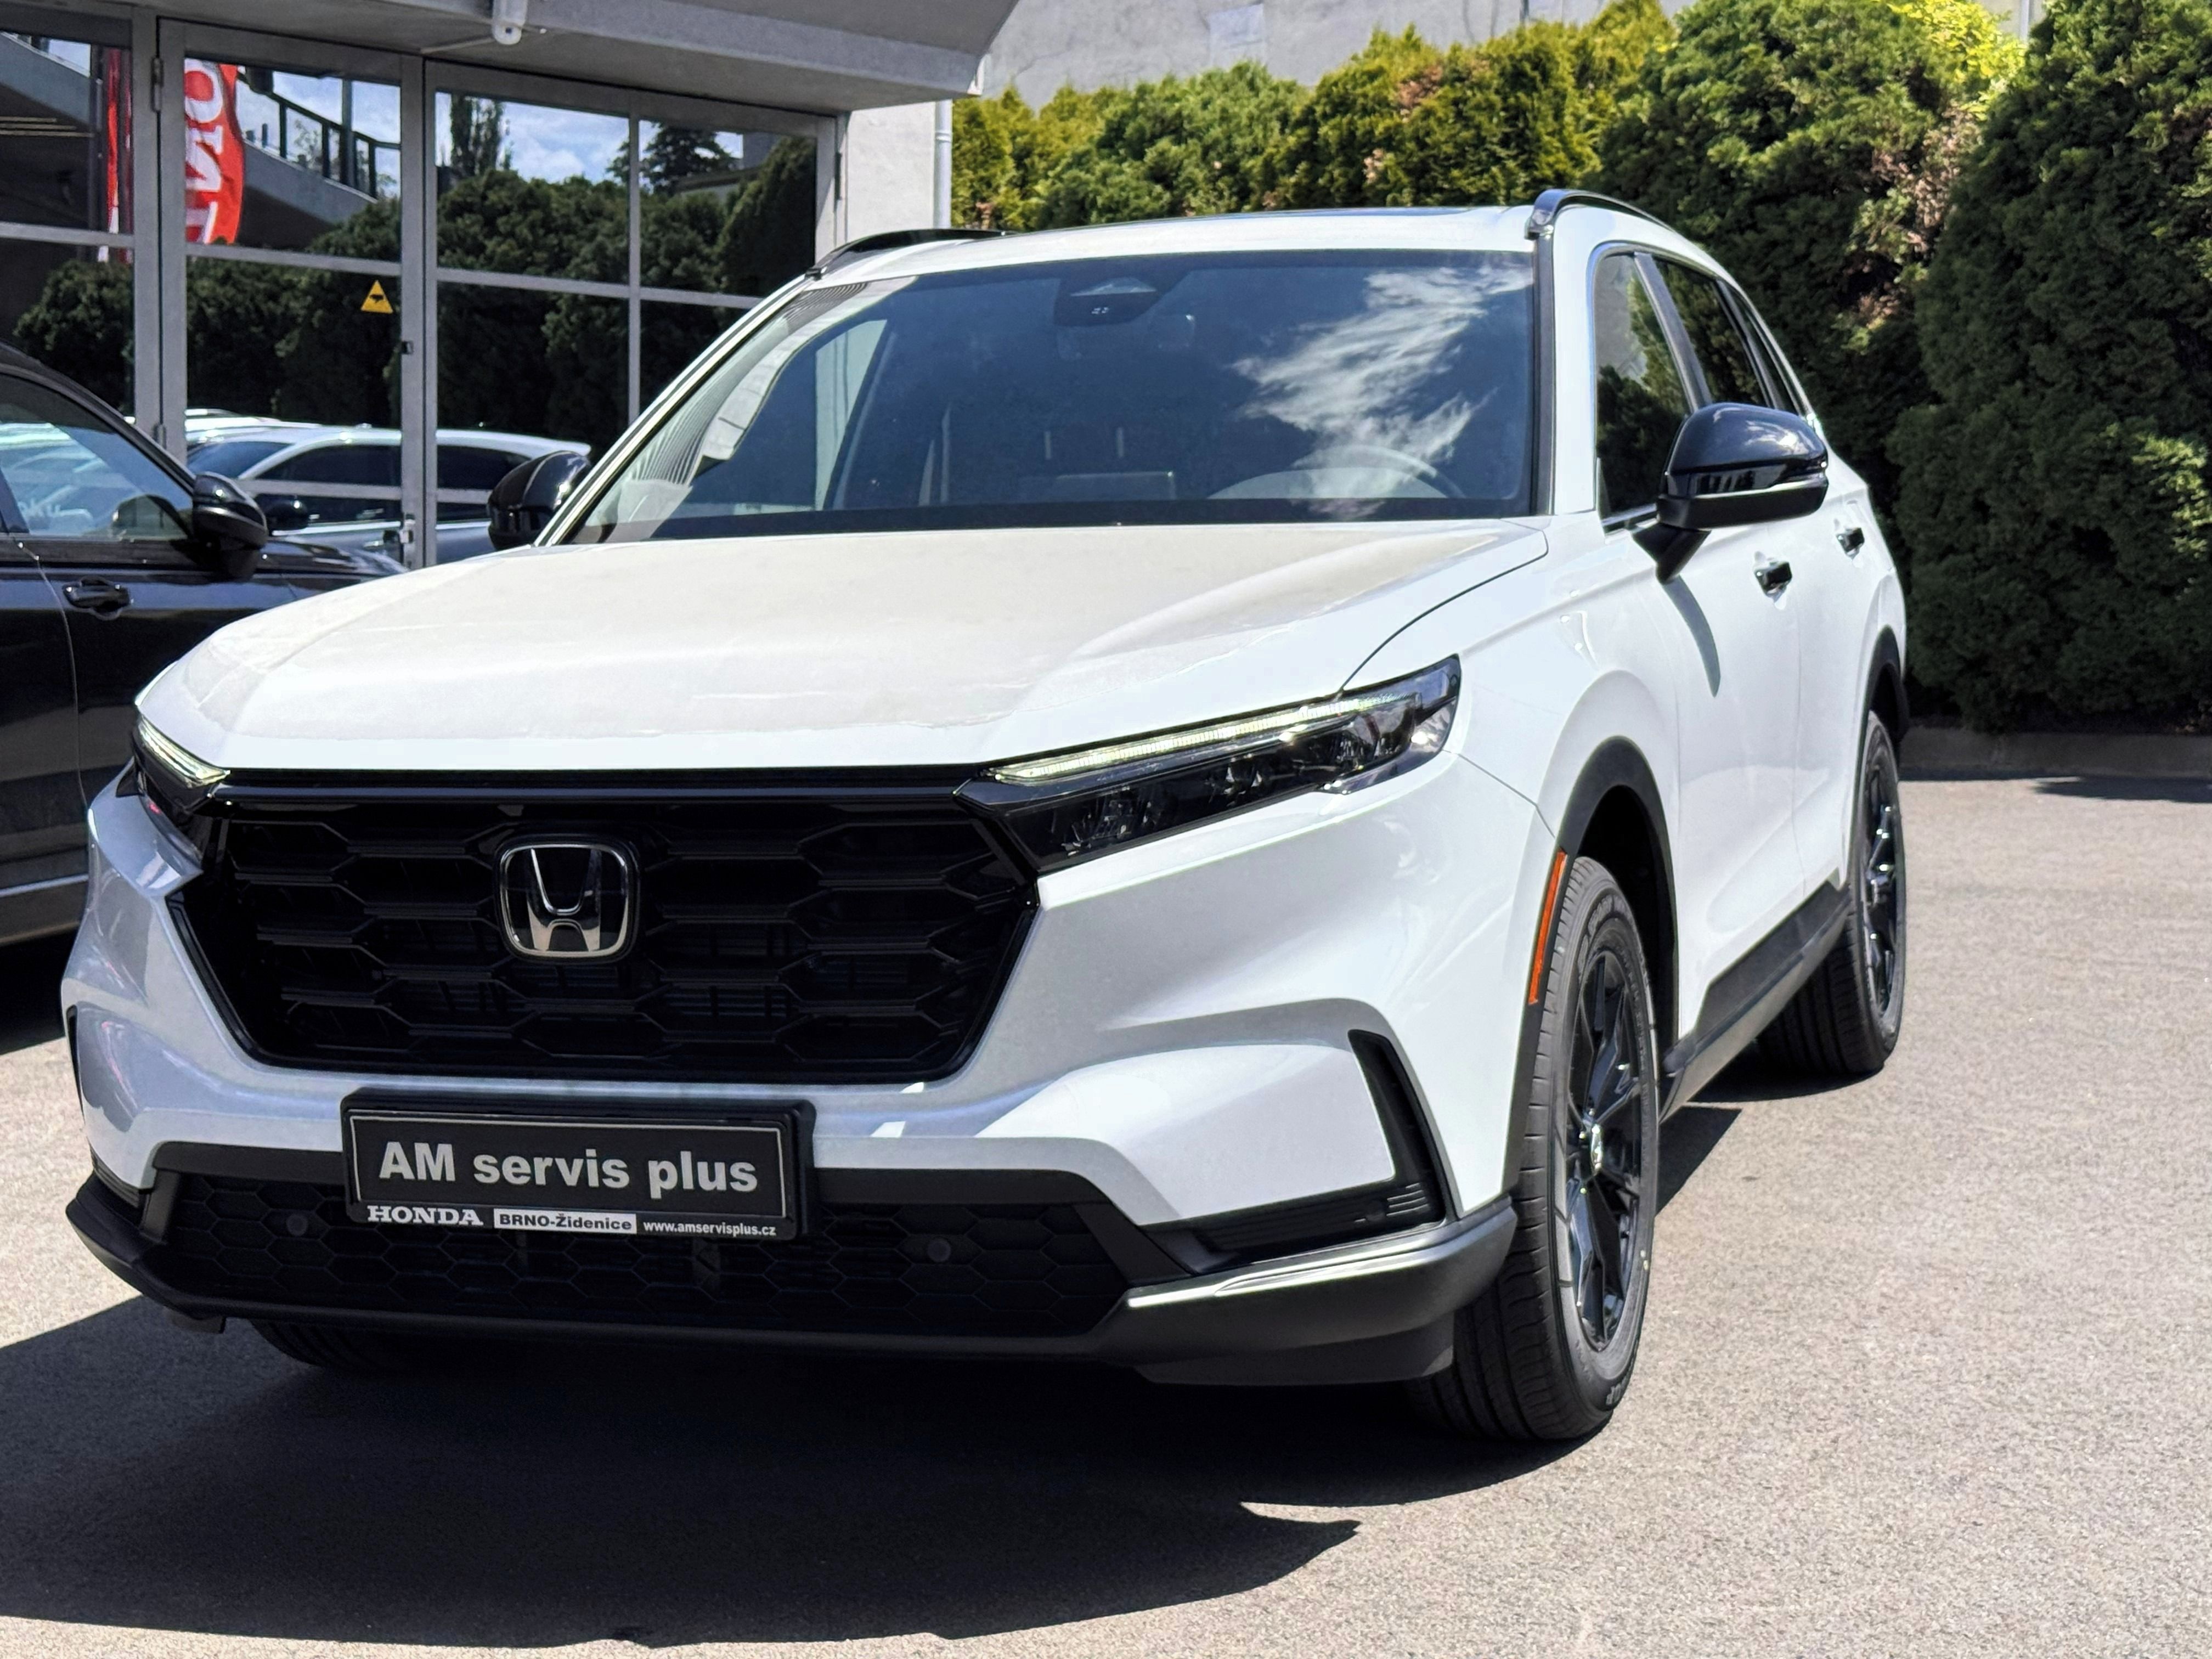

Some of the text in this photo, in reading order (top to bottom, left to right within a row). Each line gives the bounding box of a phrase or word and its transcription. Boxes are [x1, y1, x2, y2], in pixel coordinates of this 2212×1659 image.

[379, 1142, 758, 1199] AM servis plus
[367, 1205, 776, 1237] HONDA BRNO-Židenice www.amservisplus.cz
